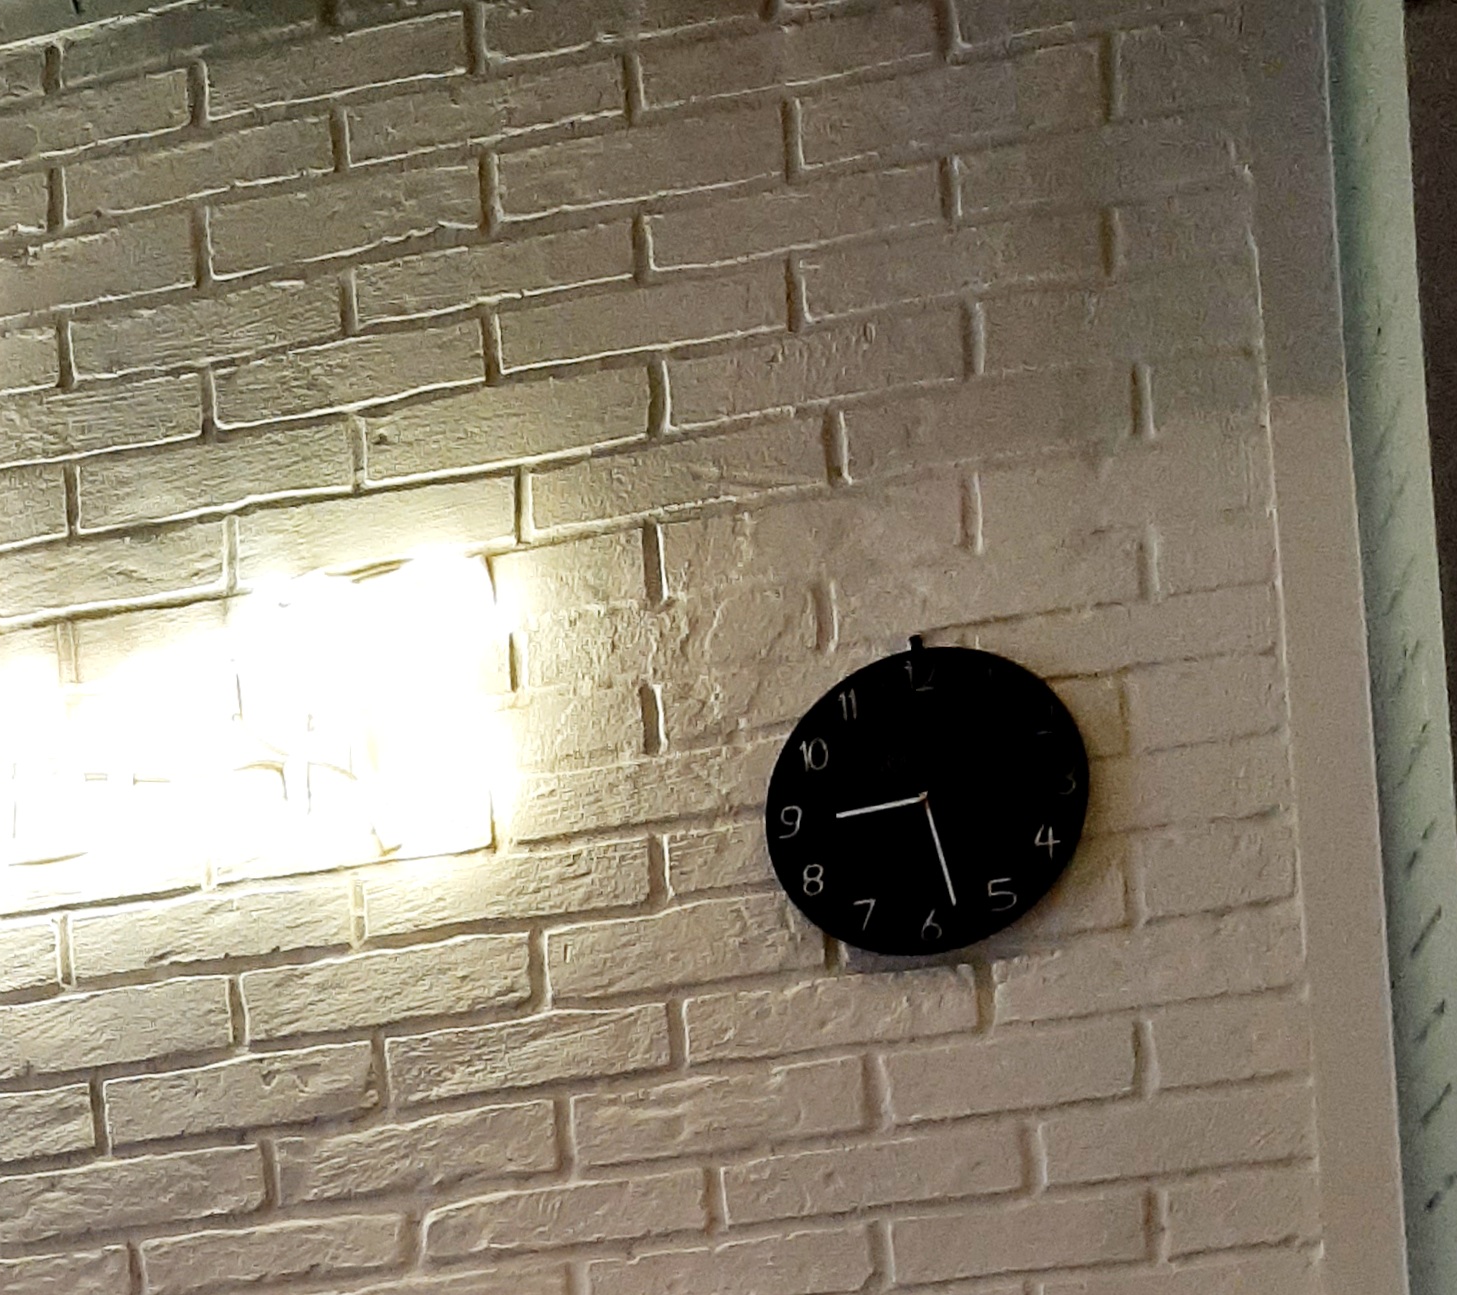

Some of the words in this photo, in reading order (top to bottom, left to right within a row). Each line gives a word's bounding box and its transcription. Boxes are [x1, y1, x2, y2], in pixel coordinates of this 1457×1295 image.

[839, 688, 858, 720] 11
[800, 737, 829, 772] 10
[778, 805, 803, 839] 9
[1034, 825, 1061, 859] 4
[802, 863, 824, 896] 8
[987, 877, 1017, 911] 5
[853, 898, 876, 930] 7
[920, 909, 942, 941] 6
